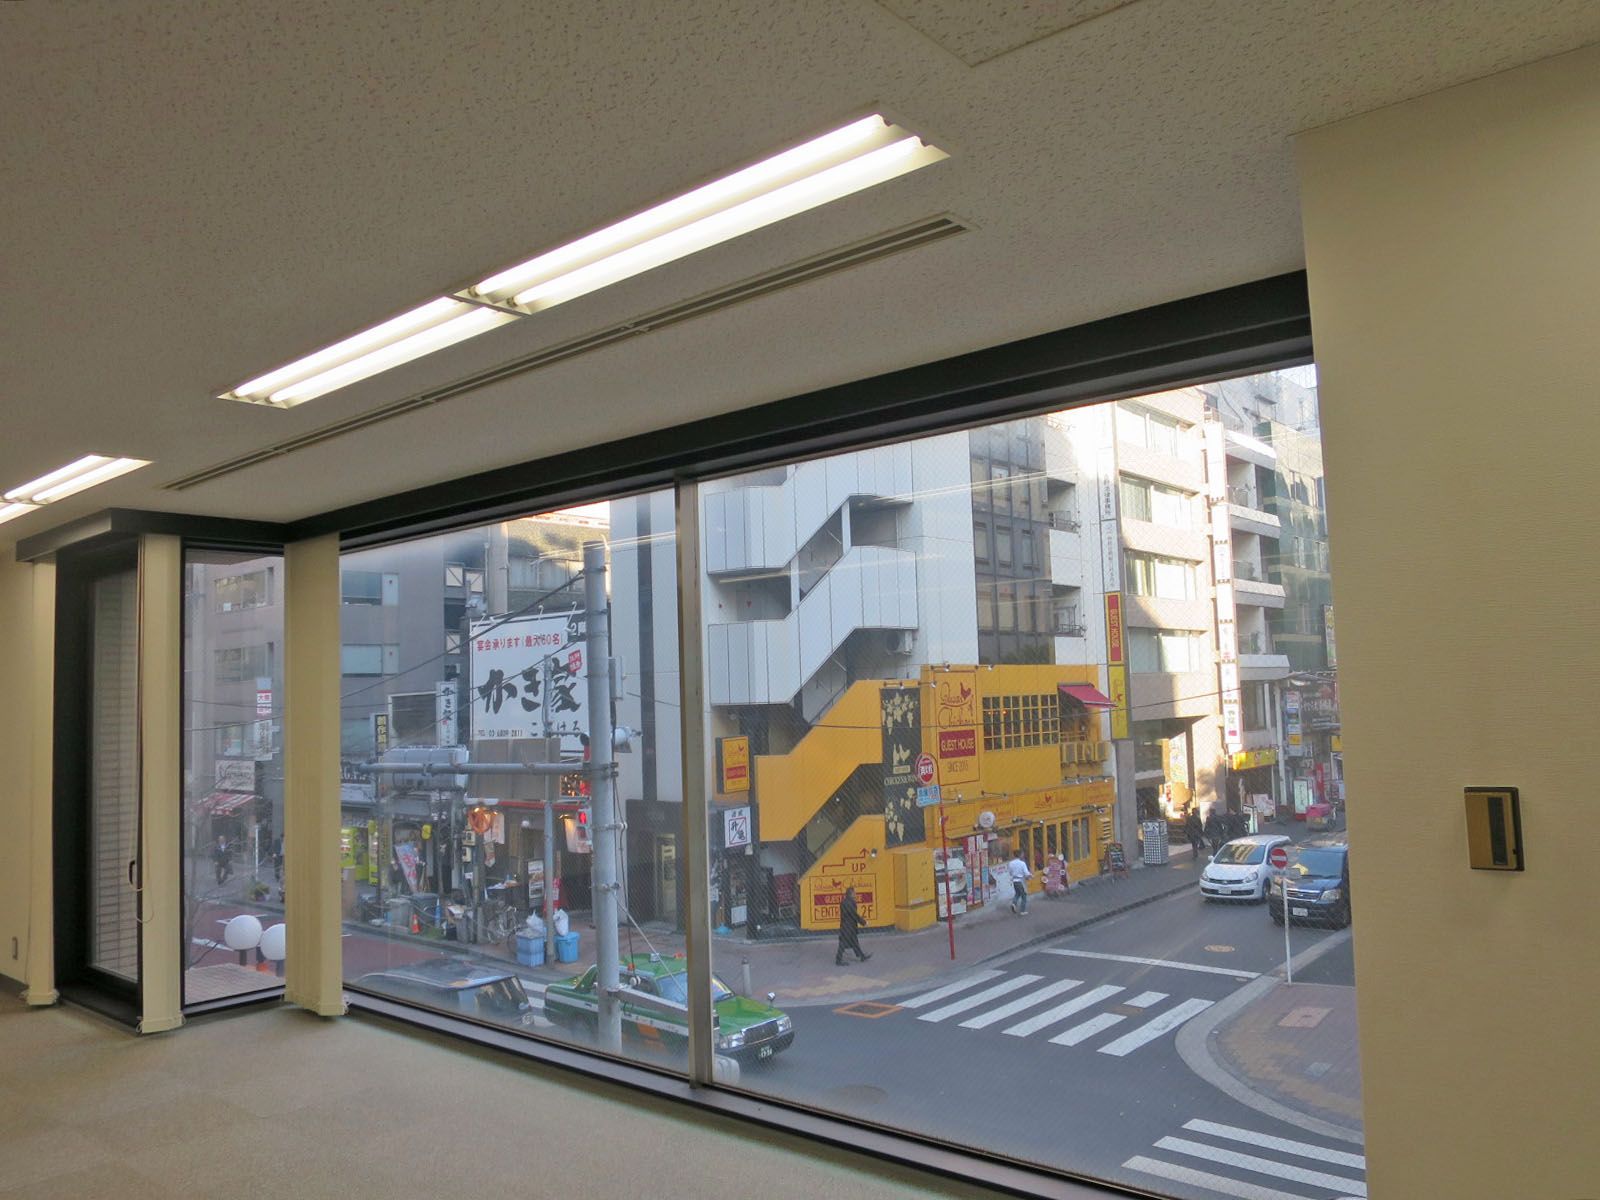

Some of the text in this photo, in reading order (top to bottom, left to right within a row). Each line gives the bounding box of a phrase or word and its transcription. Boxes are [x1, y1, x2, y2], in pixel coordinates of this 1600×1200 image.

[940, 737, 975, 752] GUEST HOUSE
[851, 862, 867, 873] UP
[860, 905, 874, 919] 2F
